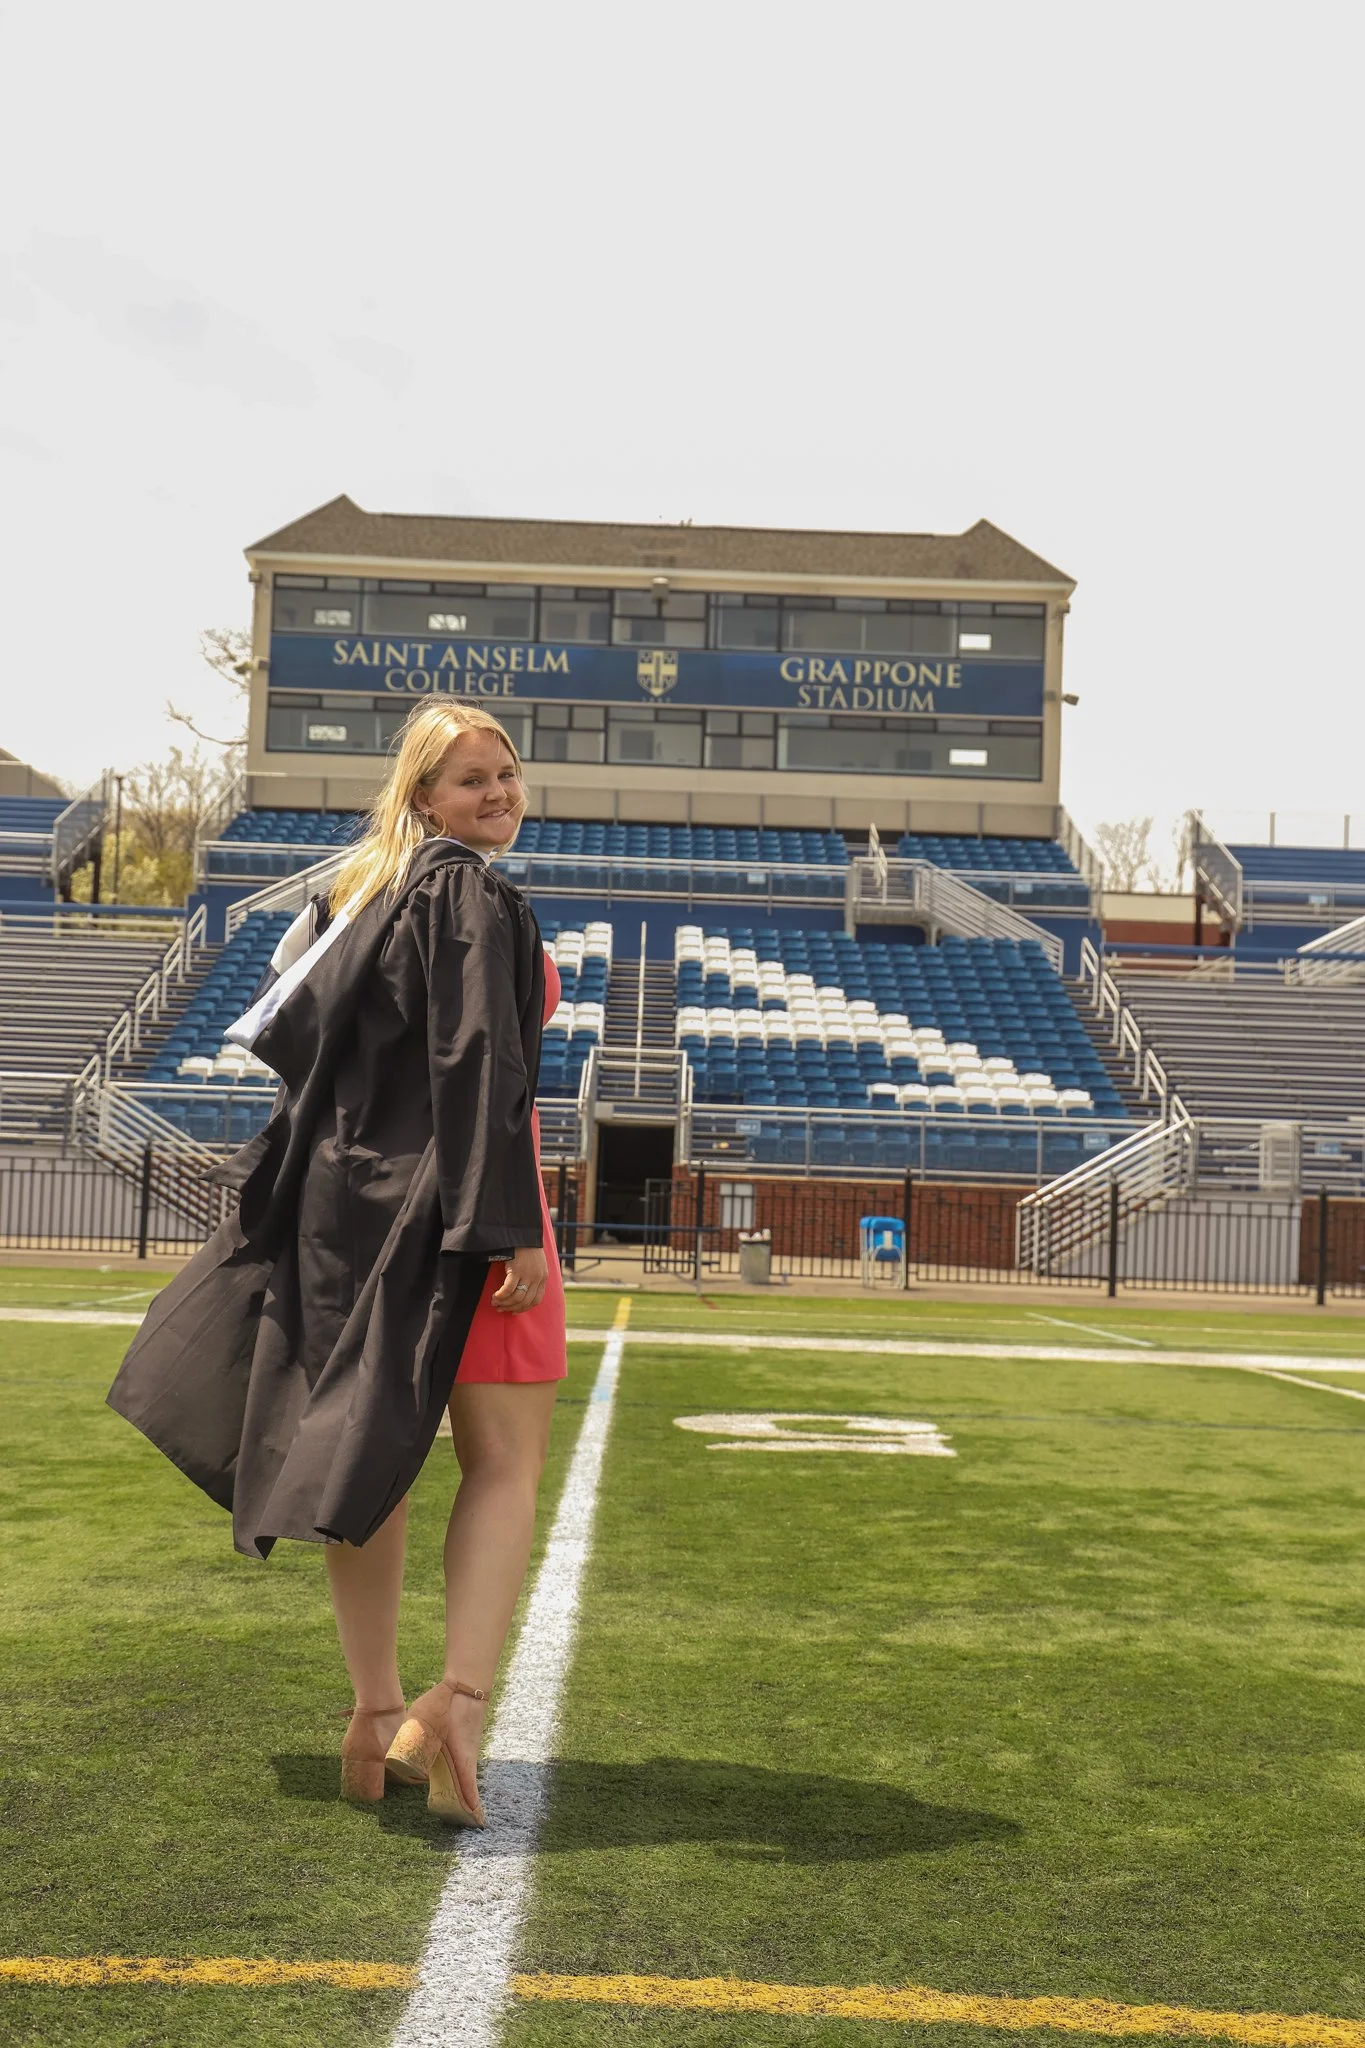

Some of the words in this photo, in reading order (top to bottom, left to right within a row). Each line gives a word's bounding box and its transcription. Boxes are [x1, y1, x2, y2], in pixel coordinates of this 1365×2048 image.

[333, 639, 432, 668] SAINT
[438, 645, 570, 674] ANSELM
[383, 668, 515, 697] COLLEGE
[780, 656, 962, 689] GRAPPONE
[798, 685, 935, 712] STADIUM
